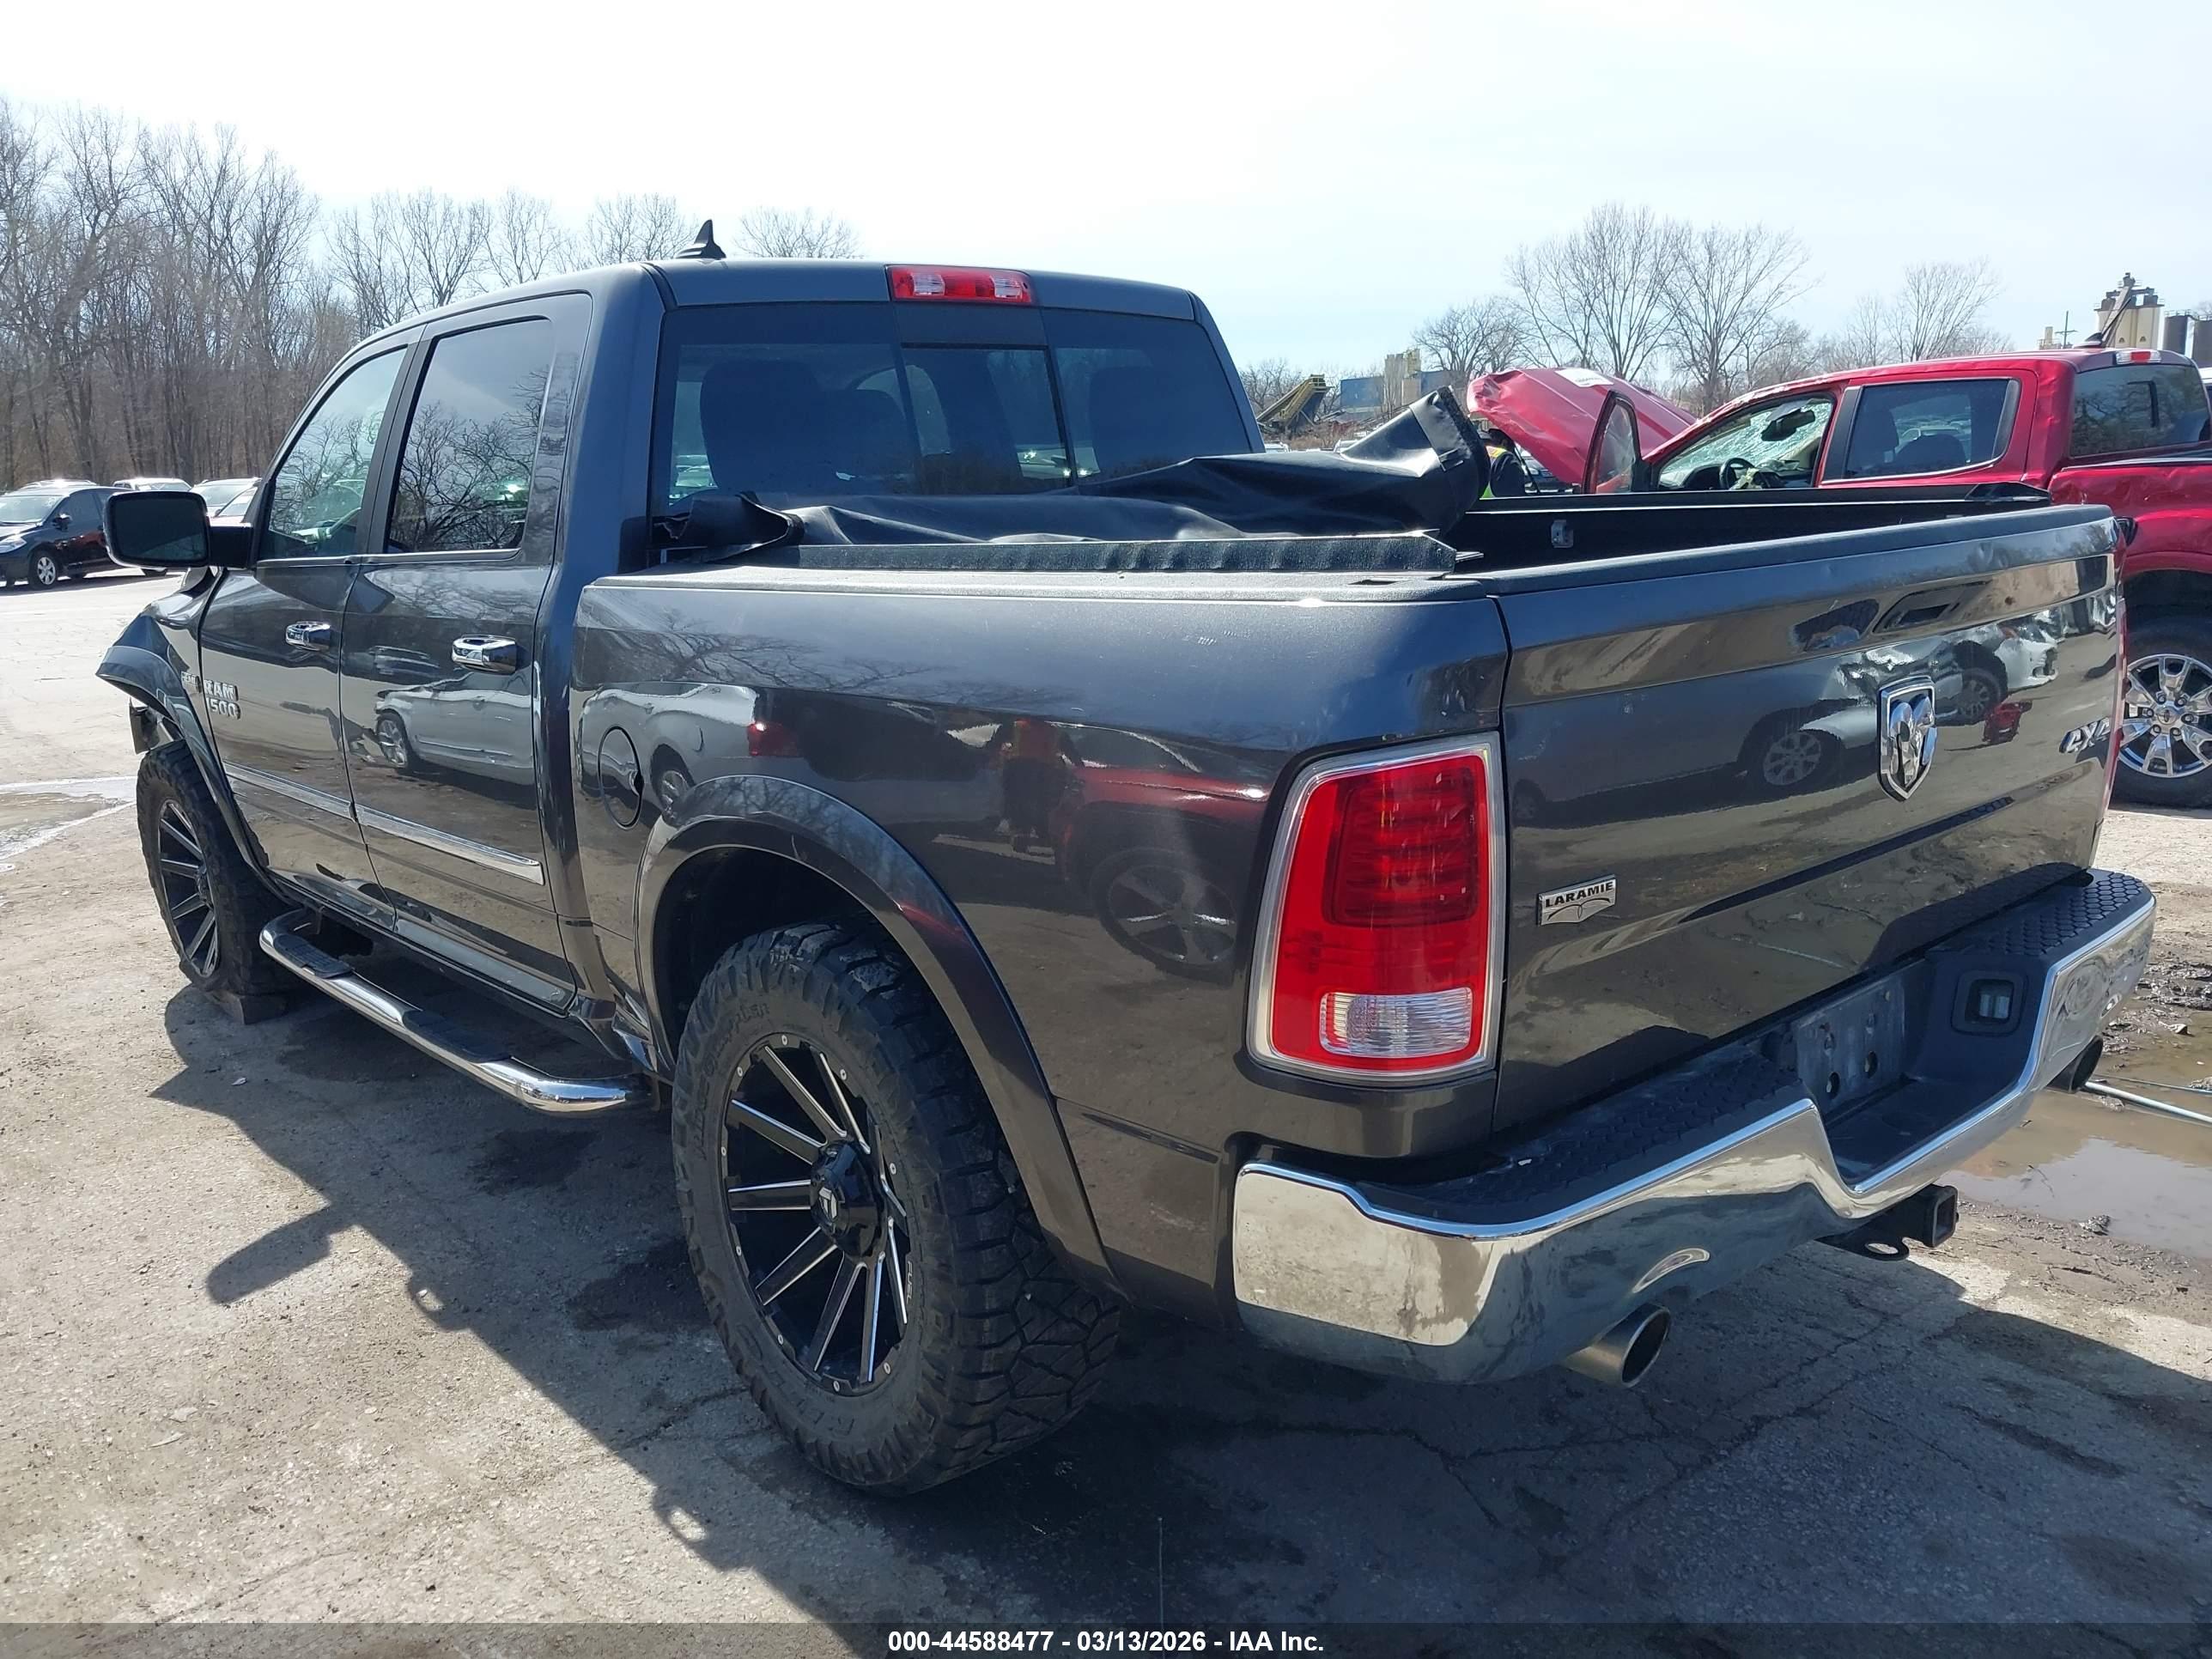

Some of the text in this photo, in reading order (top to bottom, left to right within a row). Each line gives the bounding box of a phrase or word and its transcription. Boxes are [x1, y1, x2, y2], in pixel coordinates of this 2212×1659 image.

[204, 679, 235, 700] RAM
[206, 697, 240, 718] 1500
[1546, 881, 1613, 908] LARAMIE
